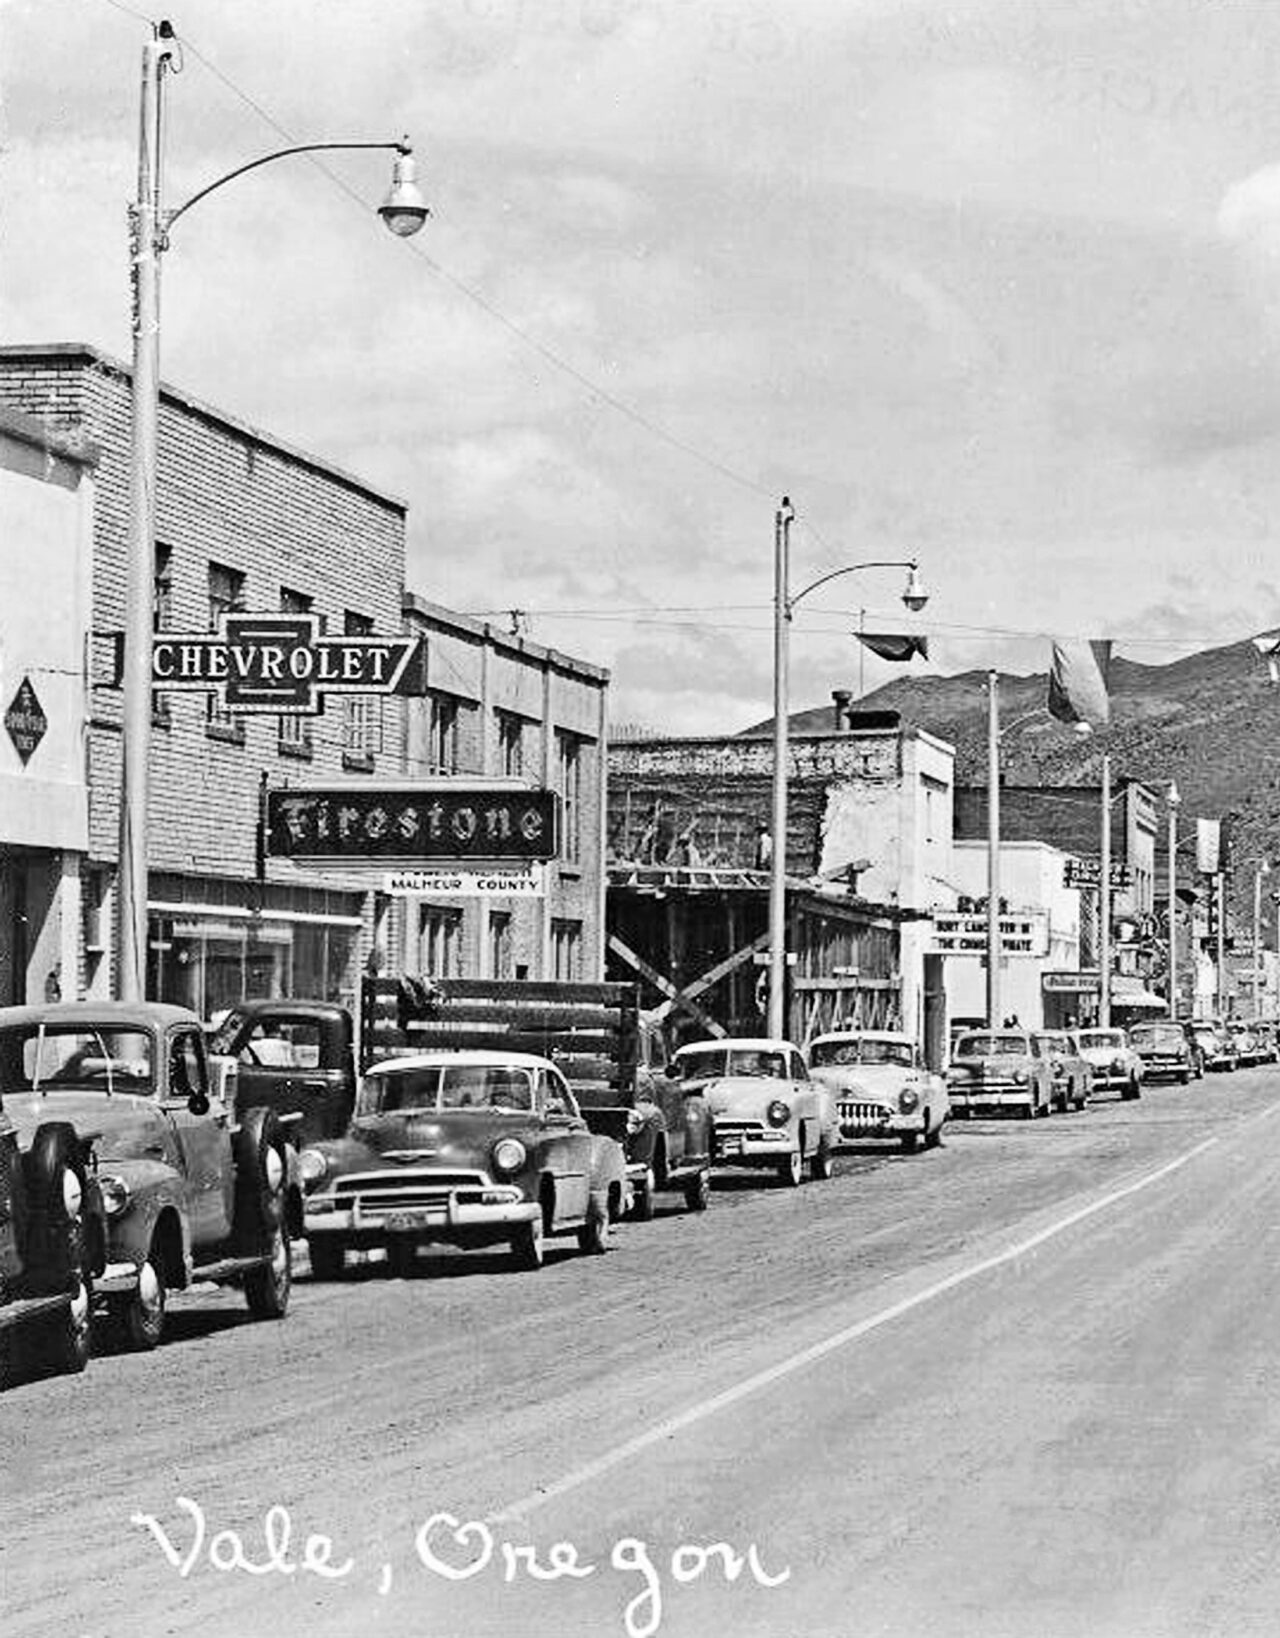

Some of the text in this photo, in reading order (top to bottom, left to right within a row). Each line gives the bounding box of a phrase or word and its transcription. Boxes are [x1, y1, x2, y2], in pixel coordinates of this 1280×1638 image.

[153, 644, 390, 682] CHEVROLET
[280, 799, 544, 842] Firestone
[391, 879, 539, 890] MALHEUR COUNTY
